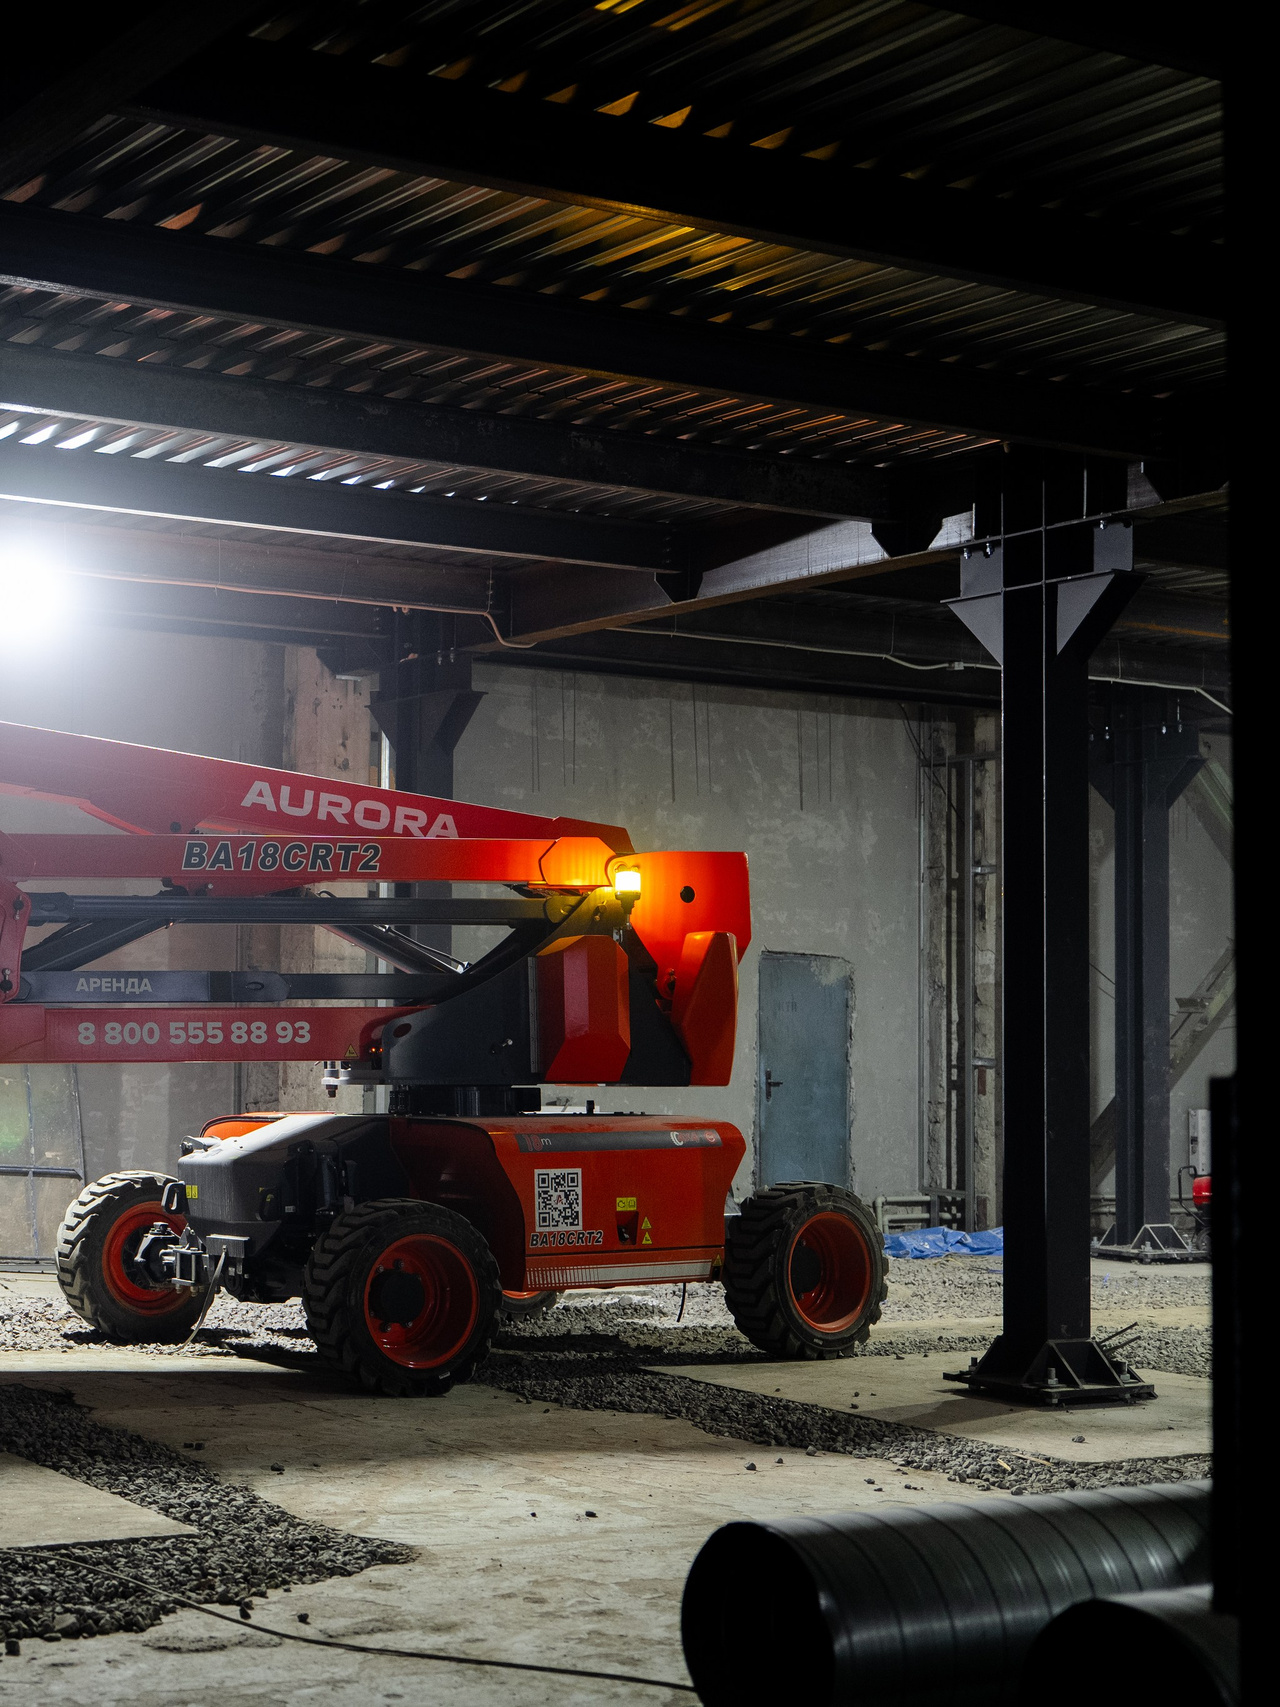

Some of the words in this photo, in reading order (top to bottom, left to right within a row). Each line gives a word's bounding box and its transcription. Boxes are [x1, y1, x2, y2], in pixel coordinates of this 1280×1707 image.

[241, 780, 459, 838] AURORA
[182, 841, 381, 872] BA18CRT2
[76, 977, 152, 994] АРЕНДА
[77, 1022, 96, 1045] 8
[104, 1022, 160, 1045] 800
[169, 1021, 224, 1044] 555
[230, 1021, 268, 1044] 88
[275, 1021, 311, 1043] 93
[529, 1231, 603, 1247] BA18CRT2
